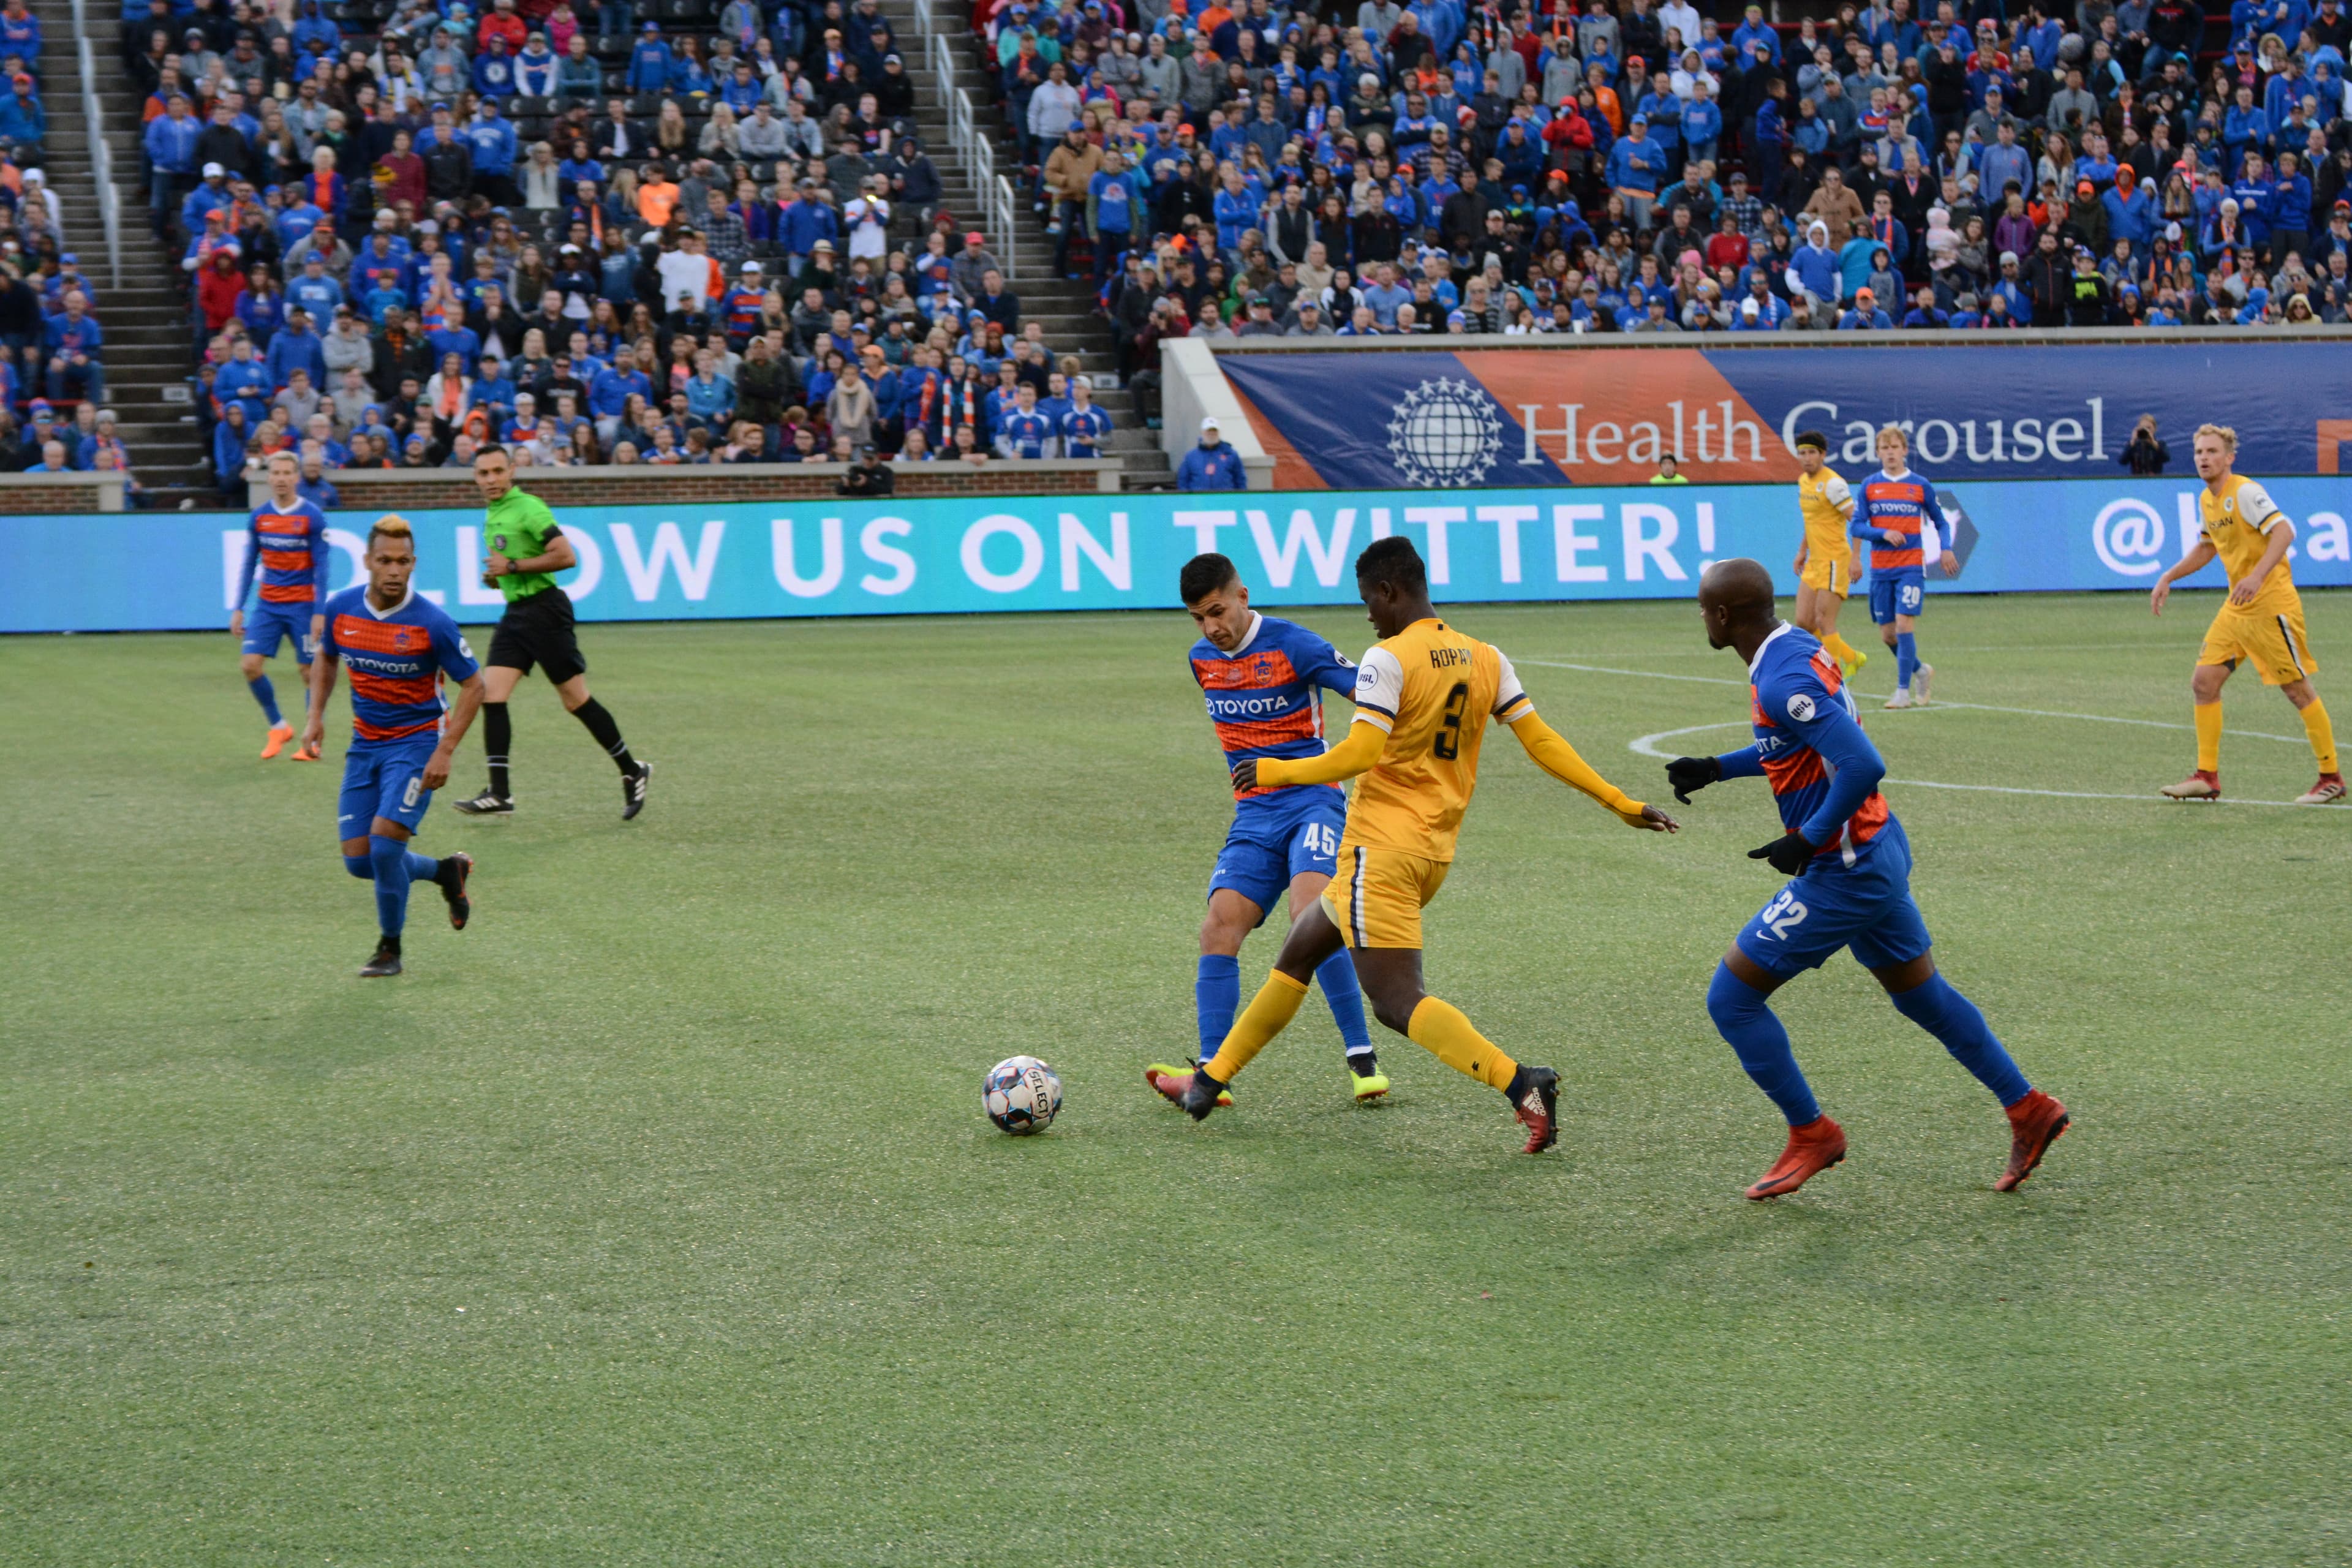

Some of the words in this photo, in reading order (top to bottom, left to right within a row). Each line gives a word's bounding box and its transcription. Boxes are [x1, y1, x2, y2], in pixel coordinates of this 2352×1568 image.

[1517, 400, 1766, 466] Health
[1880, 503, 1918, 513] TOYOTA
[771, 516, 917, 597] US
[960, 511, 1132, 594] ON
[1902, 585, 1921, 605] 20
[355, 657, 420, 673] TOYOTA
[1215, 696, 1288, 714] TOYOTA
[1791, 701, 1811, 718] USL
[1434, 681, 1469, 761] 3
[1303, 823, 1336, 856] 45
[1762, 890, 1807, 941] 32
[1029, 1071, 1048, 1114] SELECT
[1532, 1087, 1546, 1116] adidas
